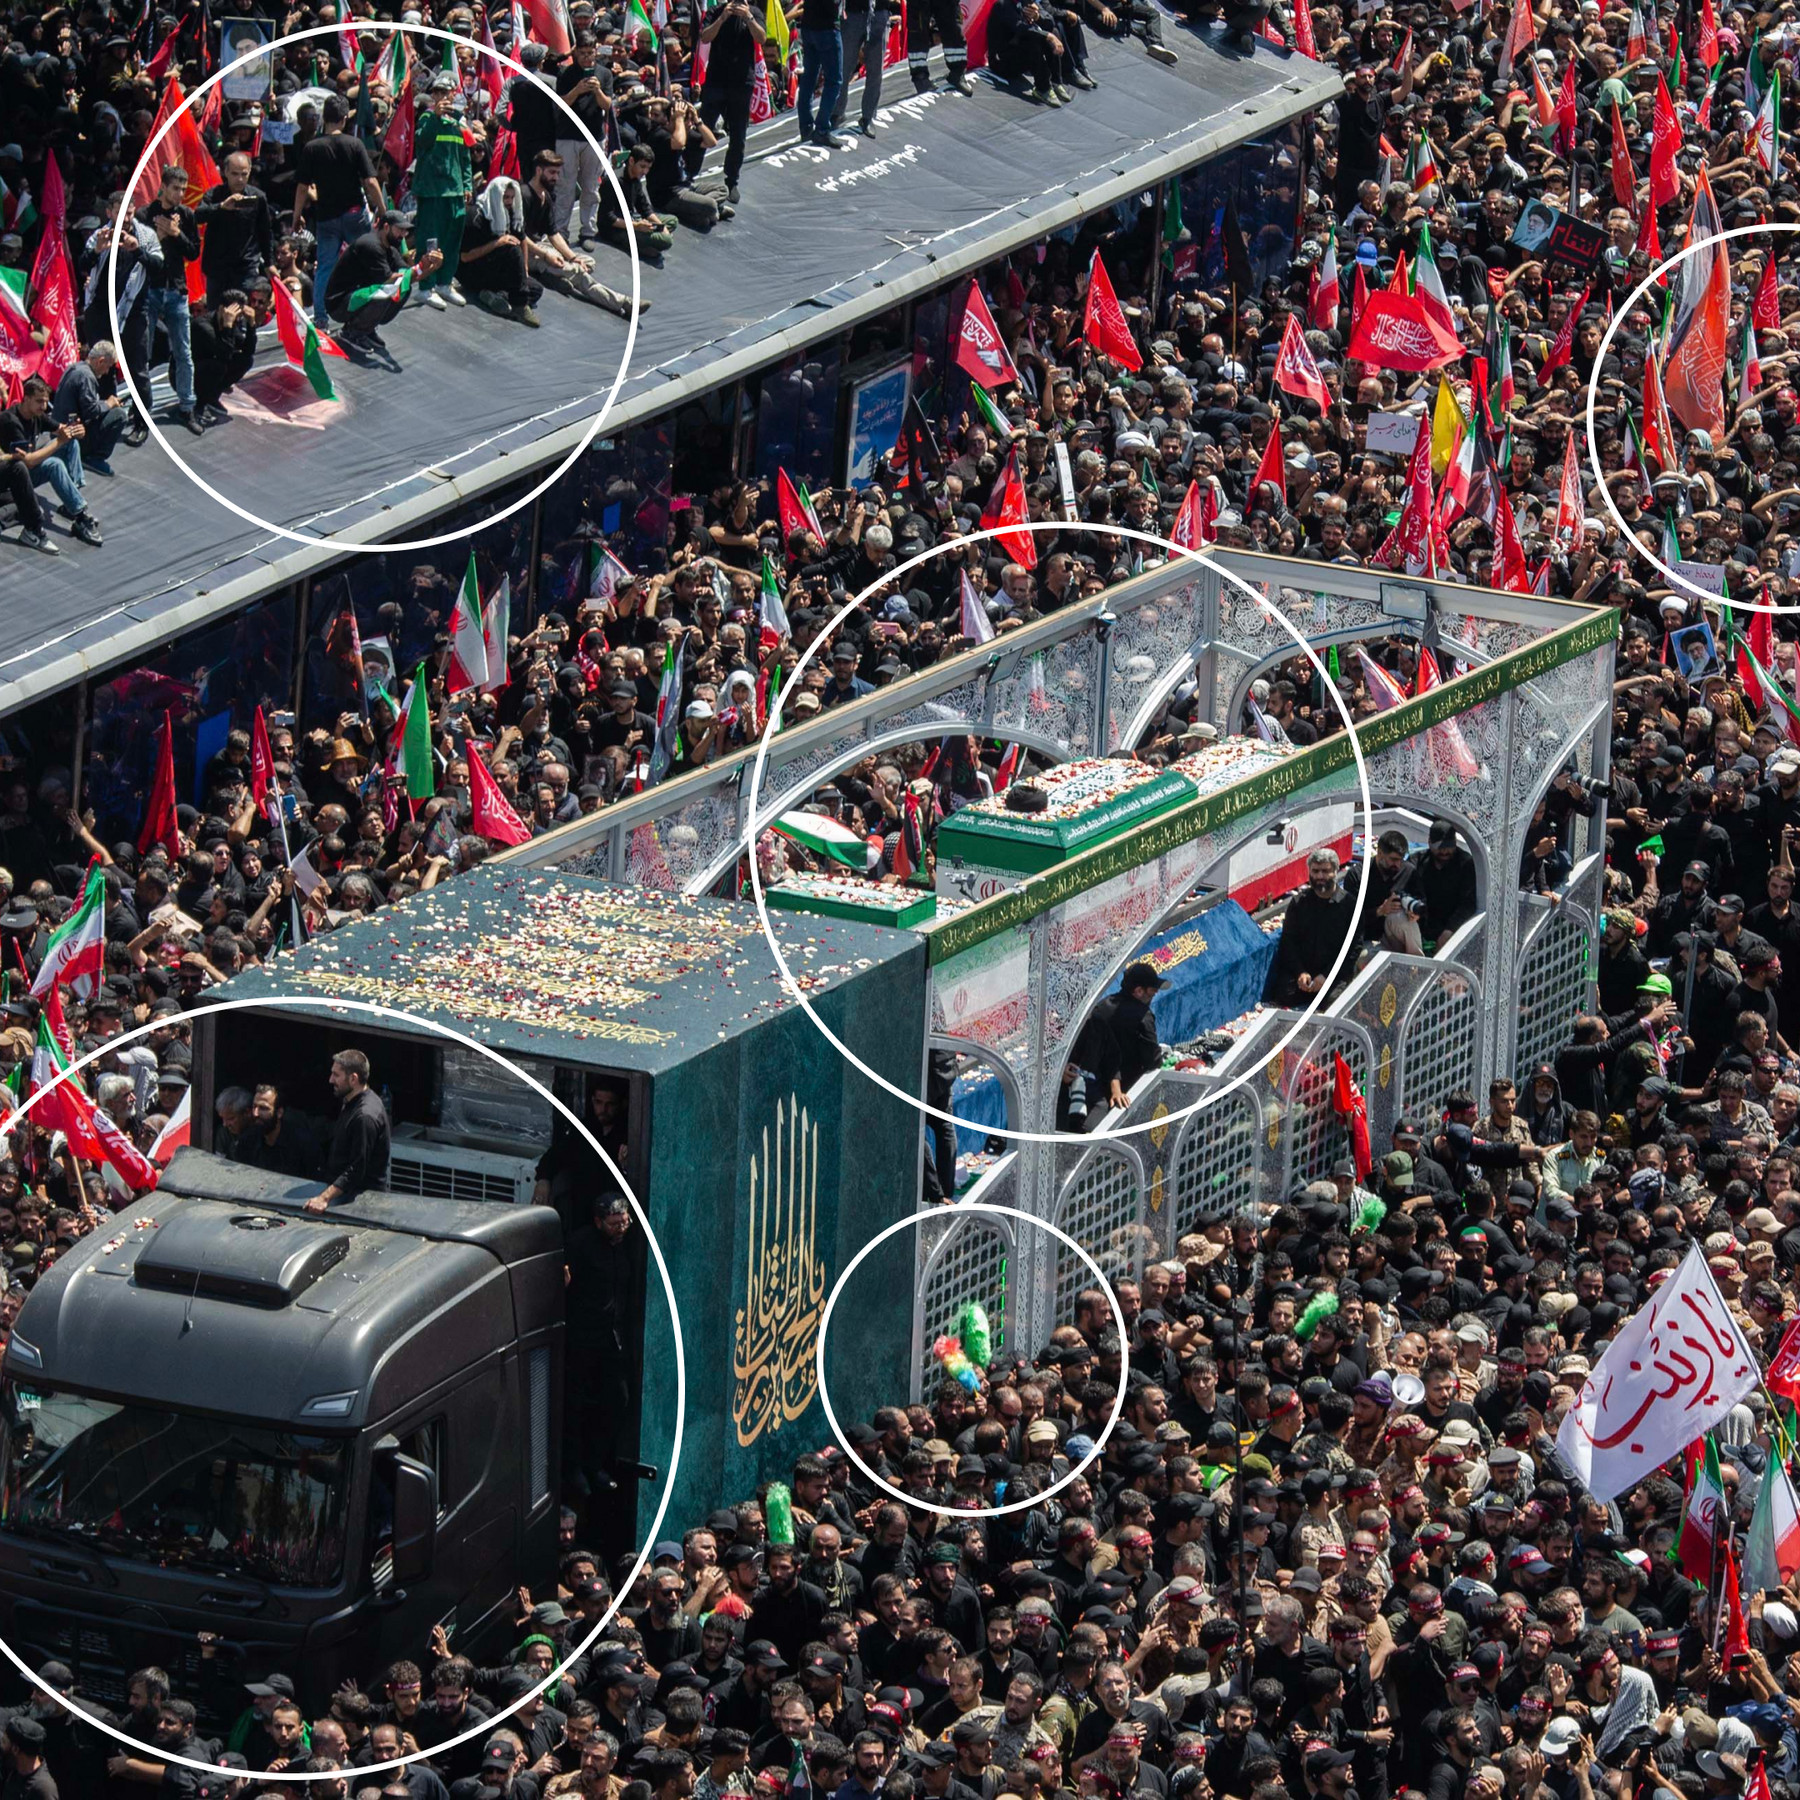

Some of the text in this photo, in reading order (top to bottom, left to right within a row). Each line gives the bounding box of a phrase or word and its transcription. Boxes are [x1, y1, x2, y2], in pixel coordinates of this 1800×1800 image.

[1549, 223, 1603, 259] انتقام
[1575, 1292, 1749, 1454] یا زینب
